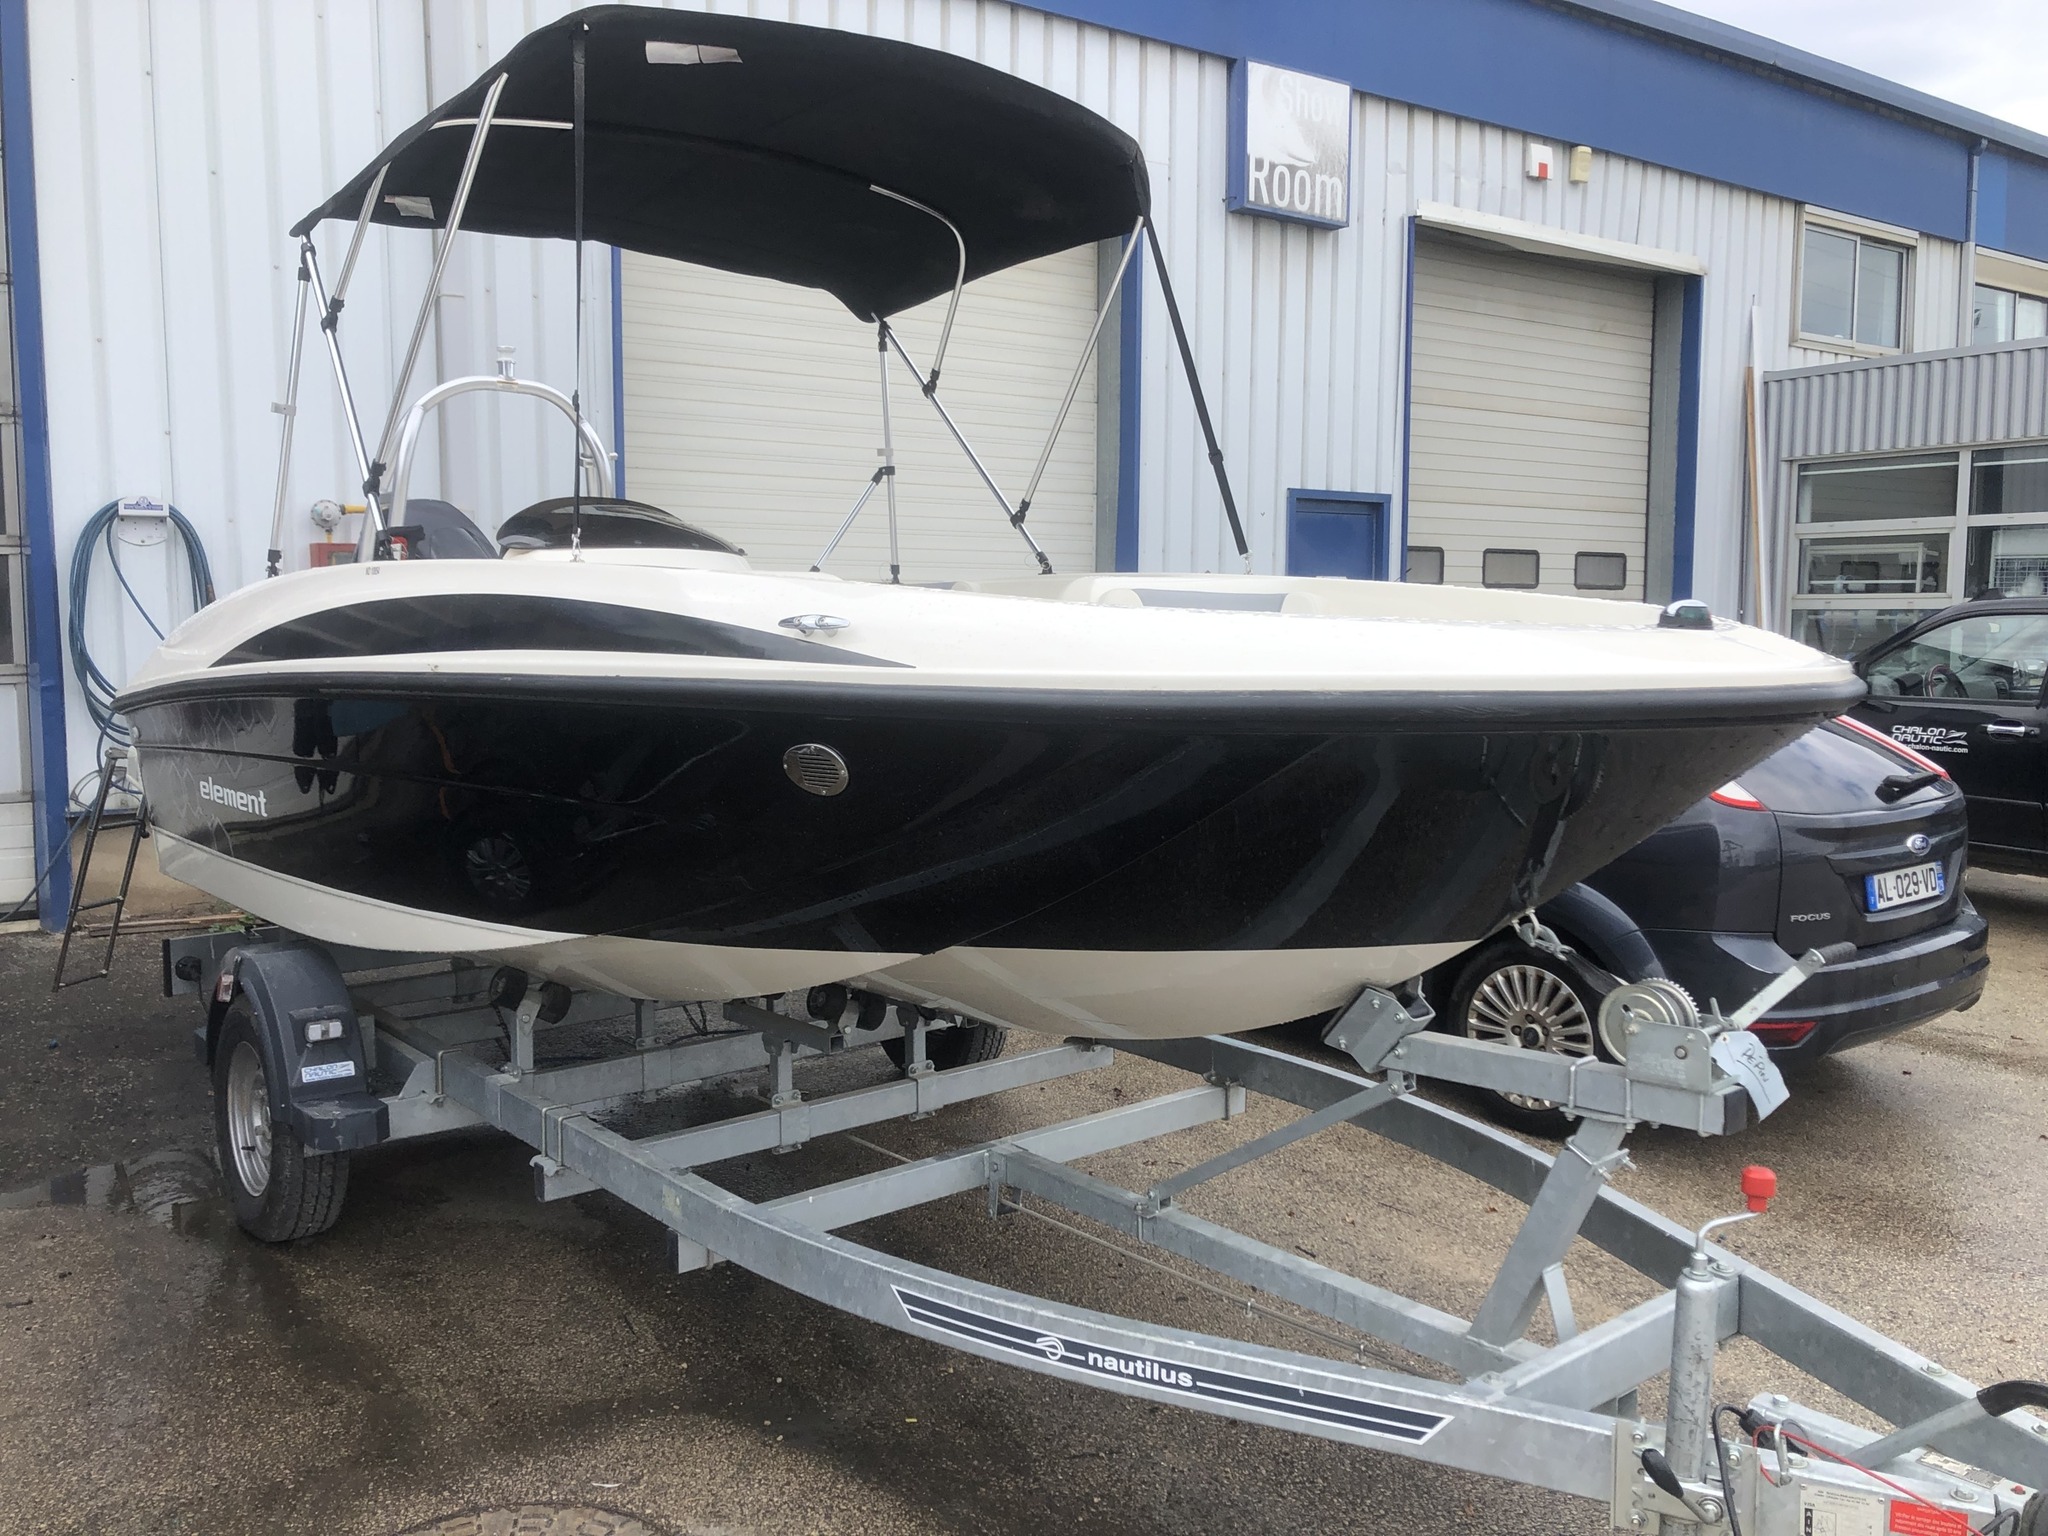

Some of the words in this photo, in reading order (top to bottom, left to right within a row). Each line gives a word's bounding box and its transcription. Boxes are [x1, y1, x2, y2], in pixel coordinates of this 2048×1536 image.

[1249, 153, 1343, 218] Room
[1892, 725, 1946, 736] CHALON
[1892, 733, 1944, 744] NAUTIC
[199, 776, 268, 817] element
[1877, 867, 1937, 904] AL-029-VD
[1790, 912, 1831, 922] FOCUS
[1088, 1351, 1193, 1387] nautilus
